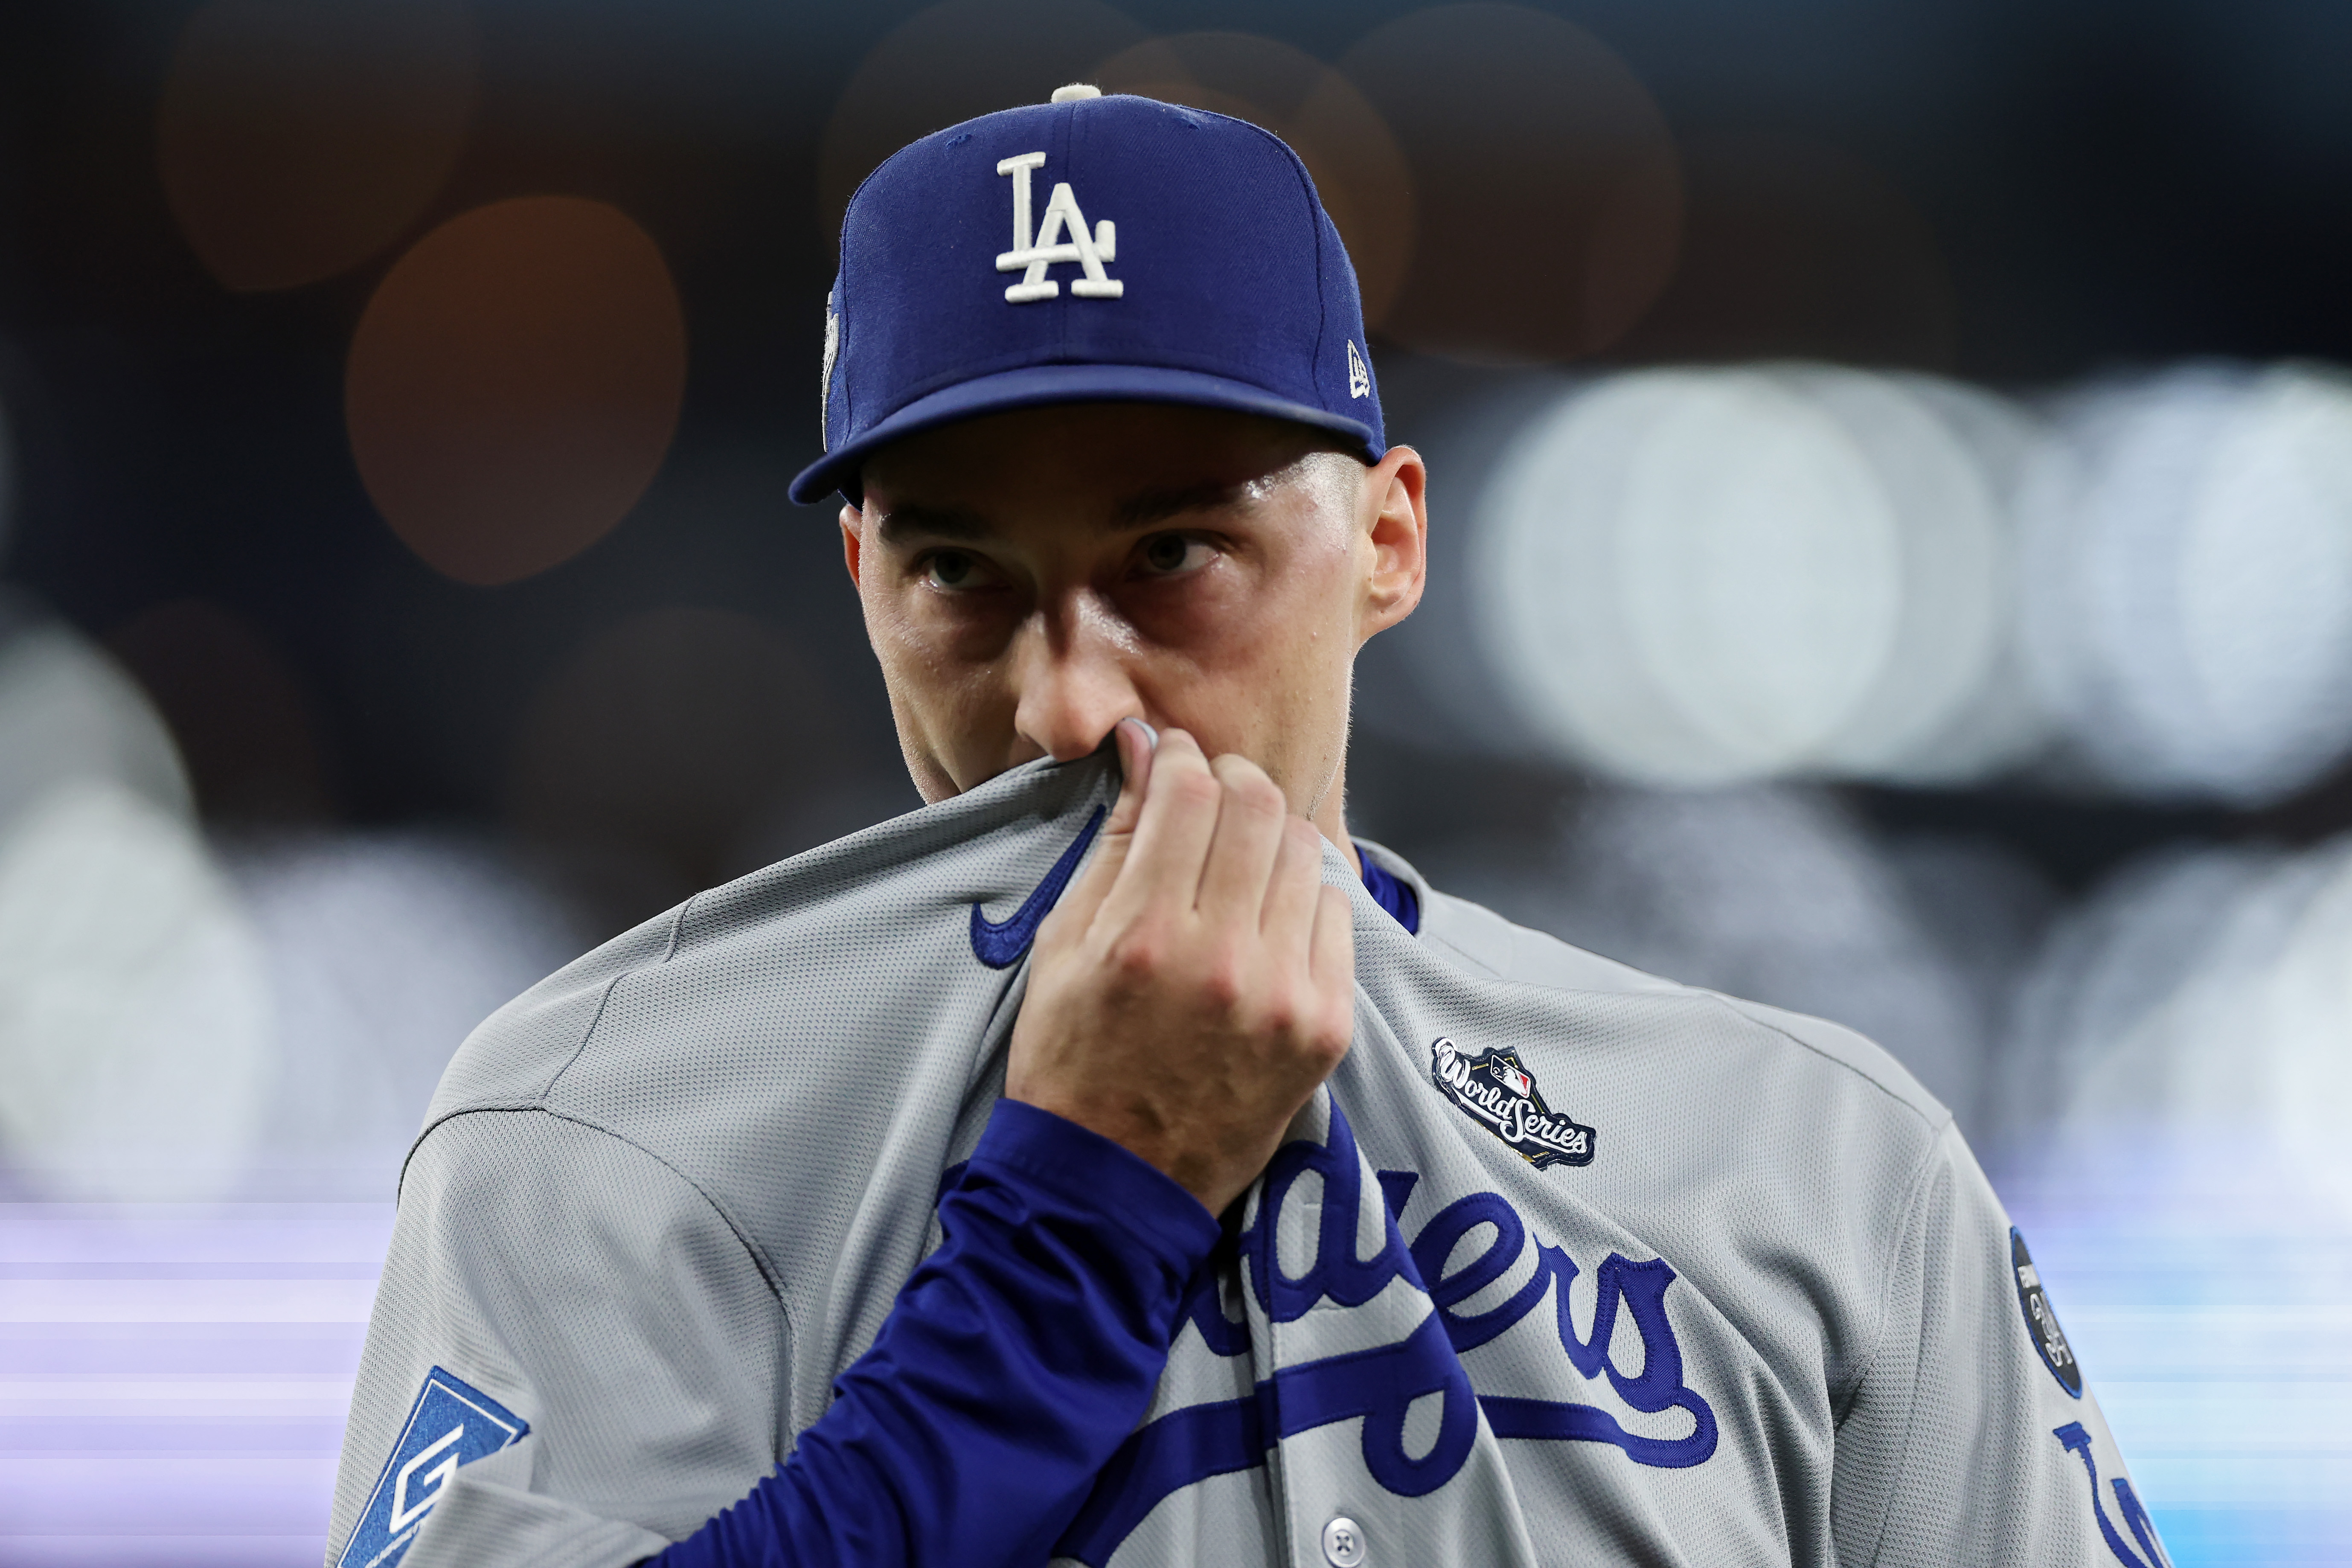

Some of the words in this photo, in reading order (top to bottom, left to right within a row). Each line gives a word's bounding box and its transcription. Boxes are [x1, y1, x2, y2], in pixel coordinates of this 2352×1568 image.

[996, 151, 1124, 303] LA
[1439, 1044, 1517, 1120] World
[1500, 1099, 1588, 1154] Series
